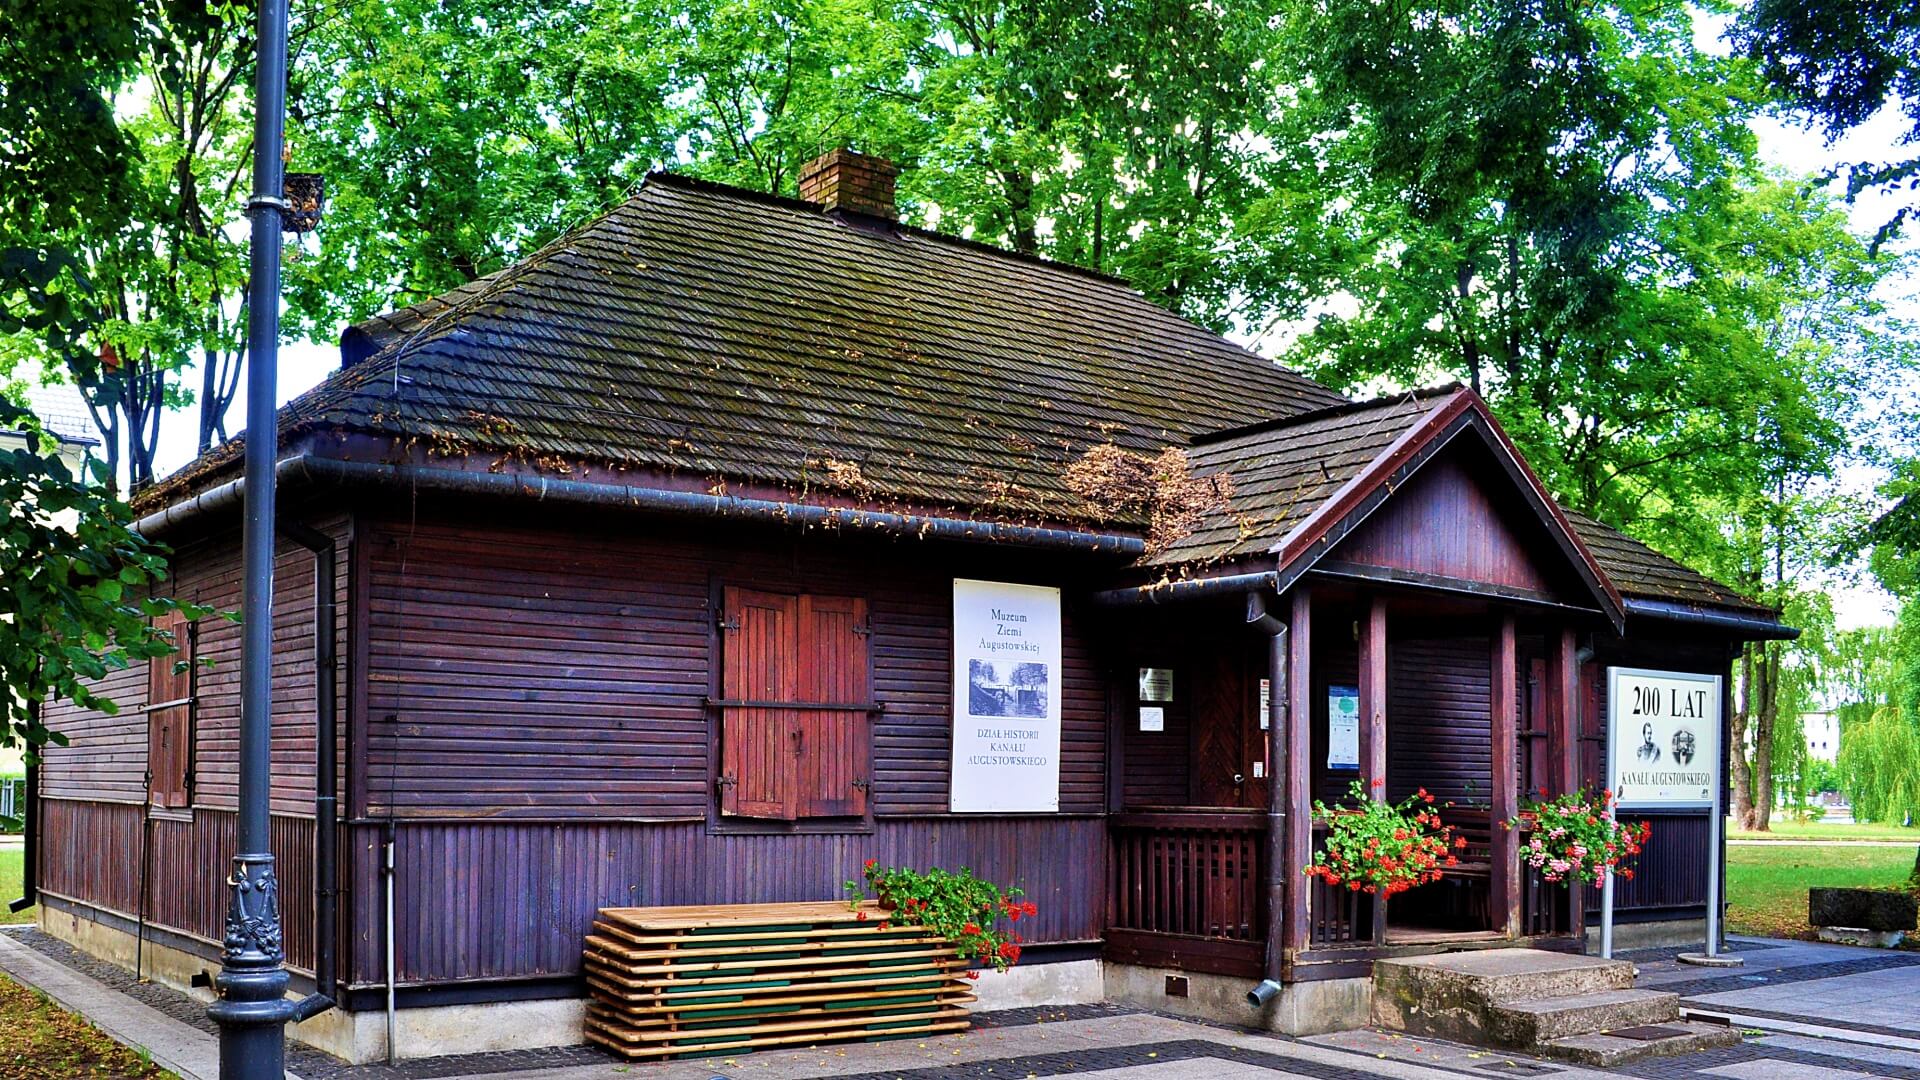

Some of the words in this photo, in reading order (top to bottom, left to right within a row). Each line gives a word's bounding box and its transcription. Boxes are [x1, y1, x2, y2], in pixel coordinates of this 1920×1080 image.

[991, 608, 1028, 622] Muzeum
[997, 623, 1022, 637] Ziemi
[979, 637, 1040, 655] Augustowskiej
[1632, 685, 1661, 716] 200
[1670, 688, 1707, 718] LAT
[977, 728, 1002, 739] DZIAŁ
[1003, 729, 1039, 740] HISTORII
[990, 742, 1026, 752] KANAŁU
[967, 755, 1047, 766] AUGUSTOWSKIEGO
[1622, 771, 1649, 786] KANAŁU
[1651, 771, 1711, 786] AUGUSTOWSKIEGO
